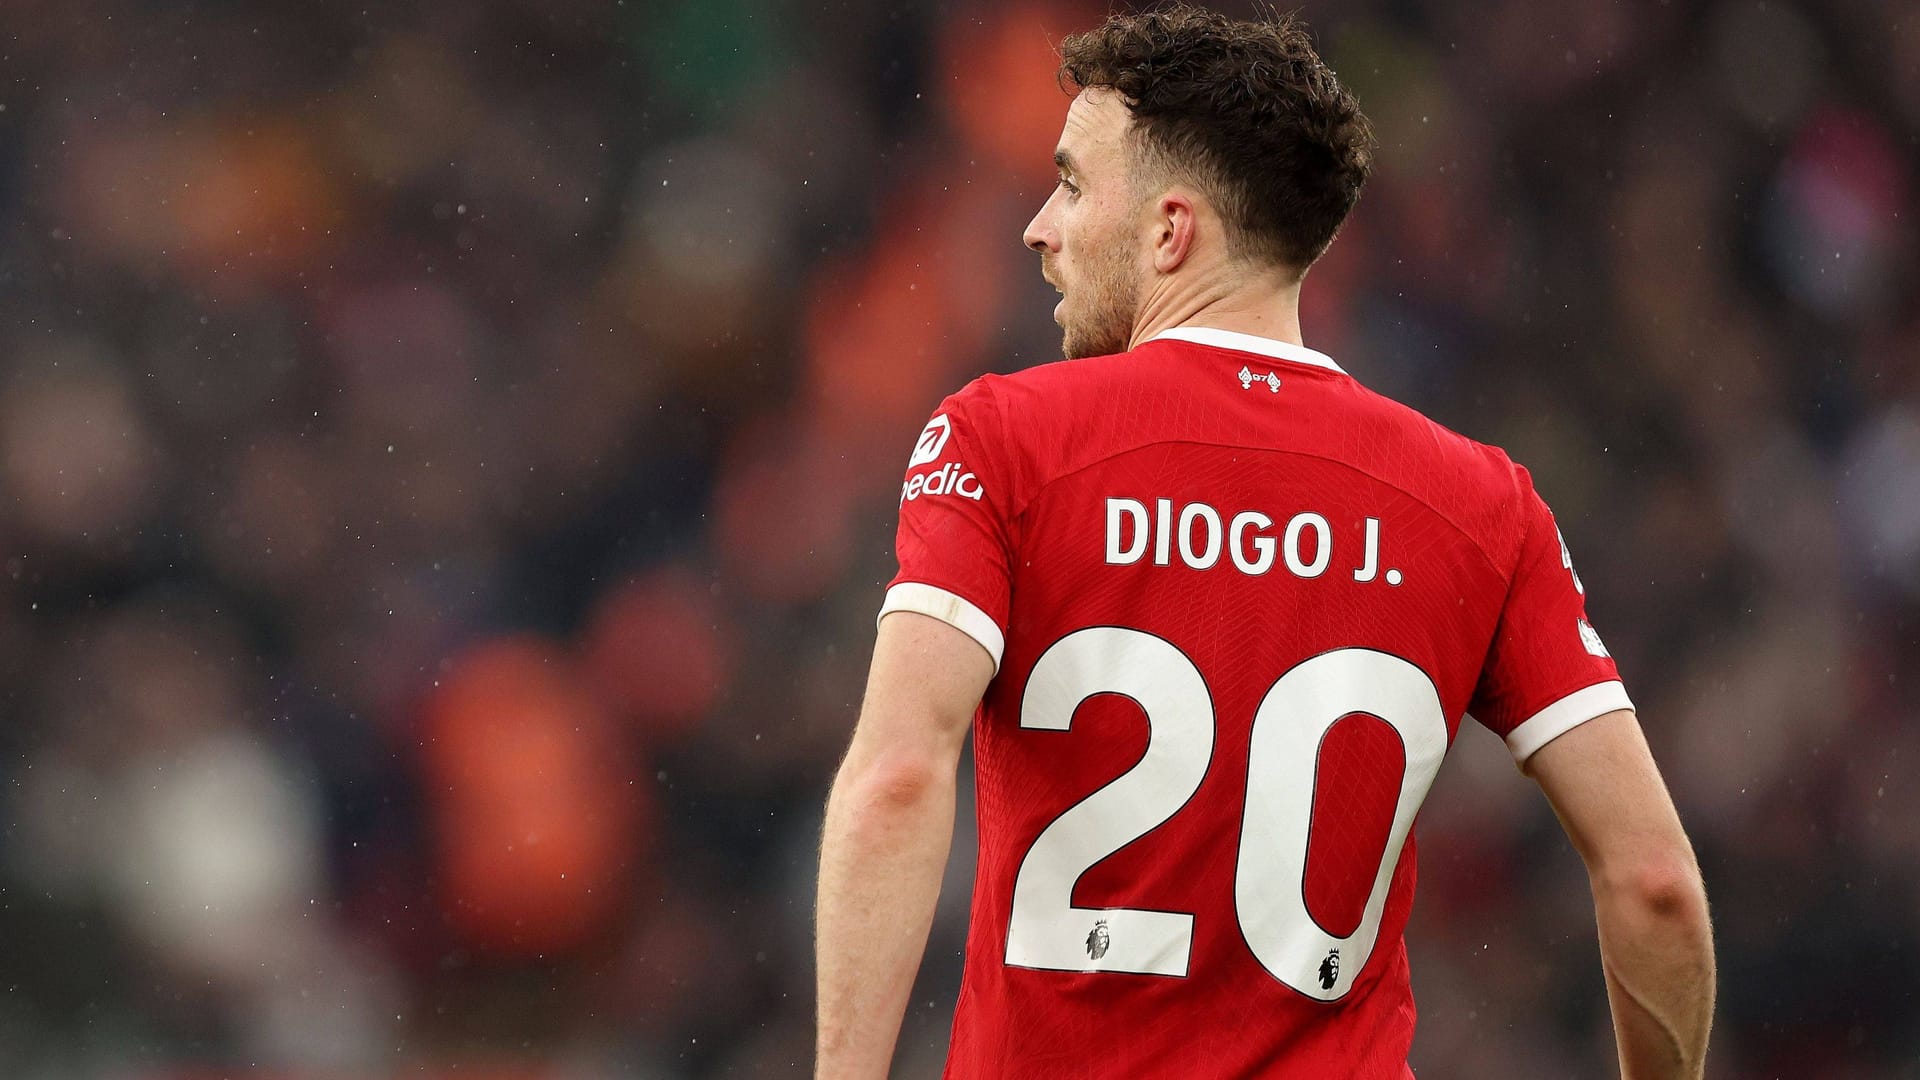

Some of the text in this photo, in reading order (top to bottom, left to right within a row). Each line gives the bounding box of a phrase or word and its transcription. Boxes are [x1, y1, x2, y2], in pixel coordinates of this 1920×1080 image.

[1104, 497, 1404, 586] DIOGO J.
[1003, 625, 1450, 1005] 20
